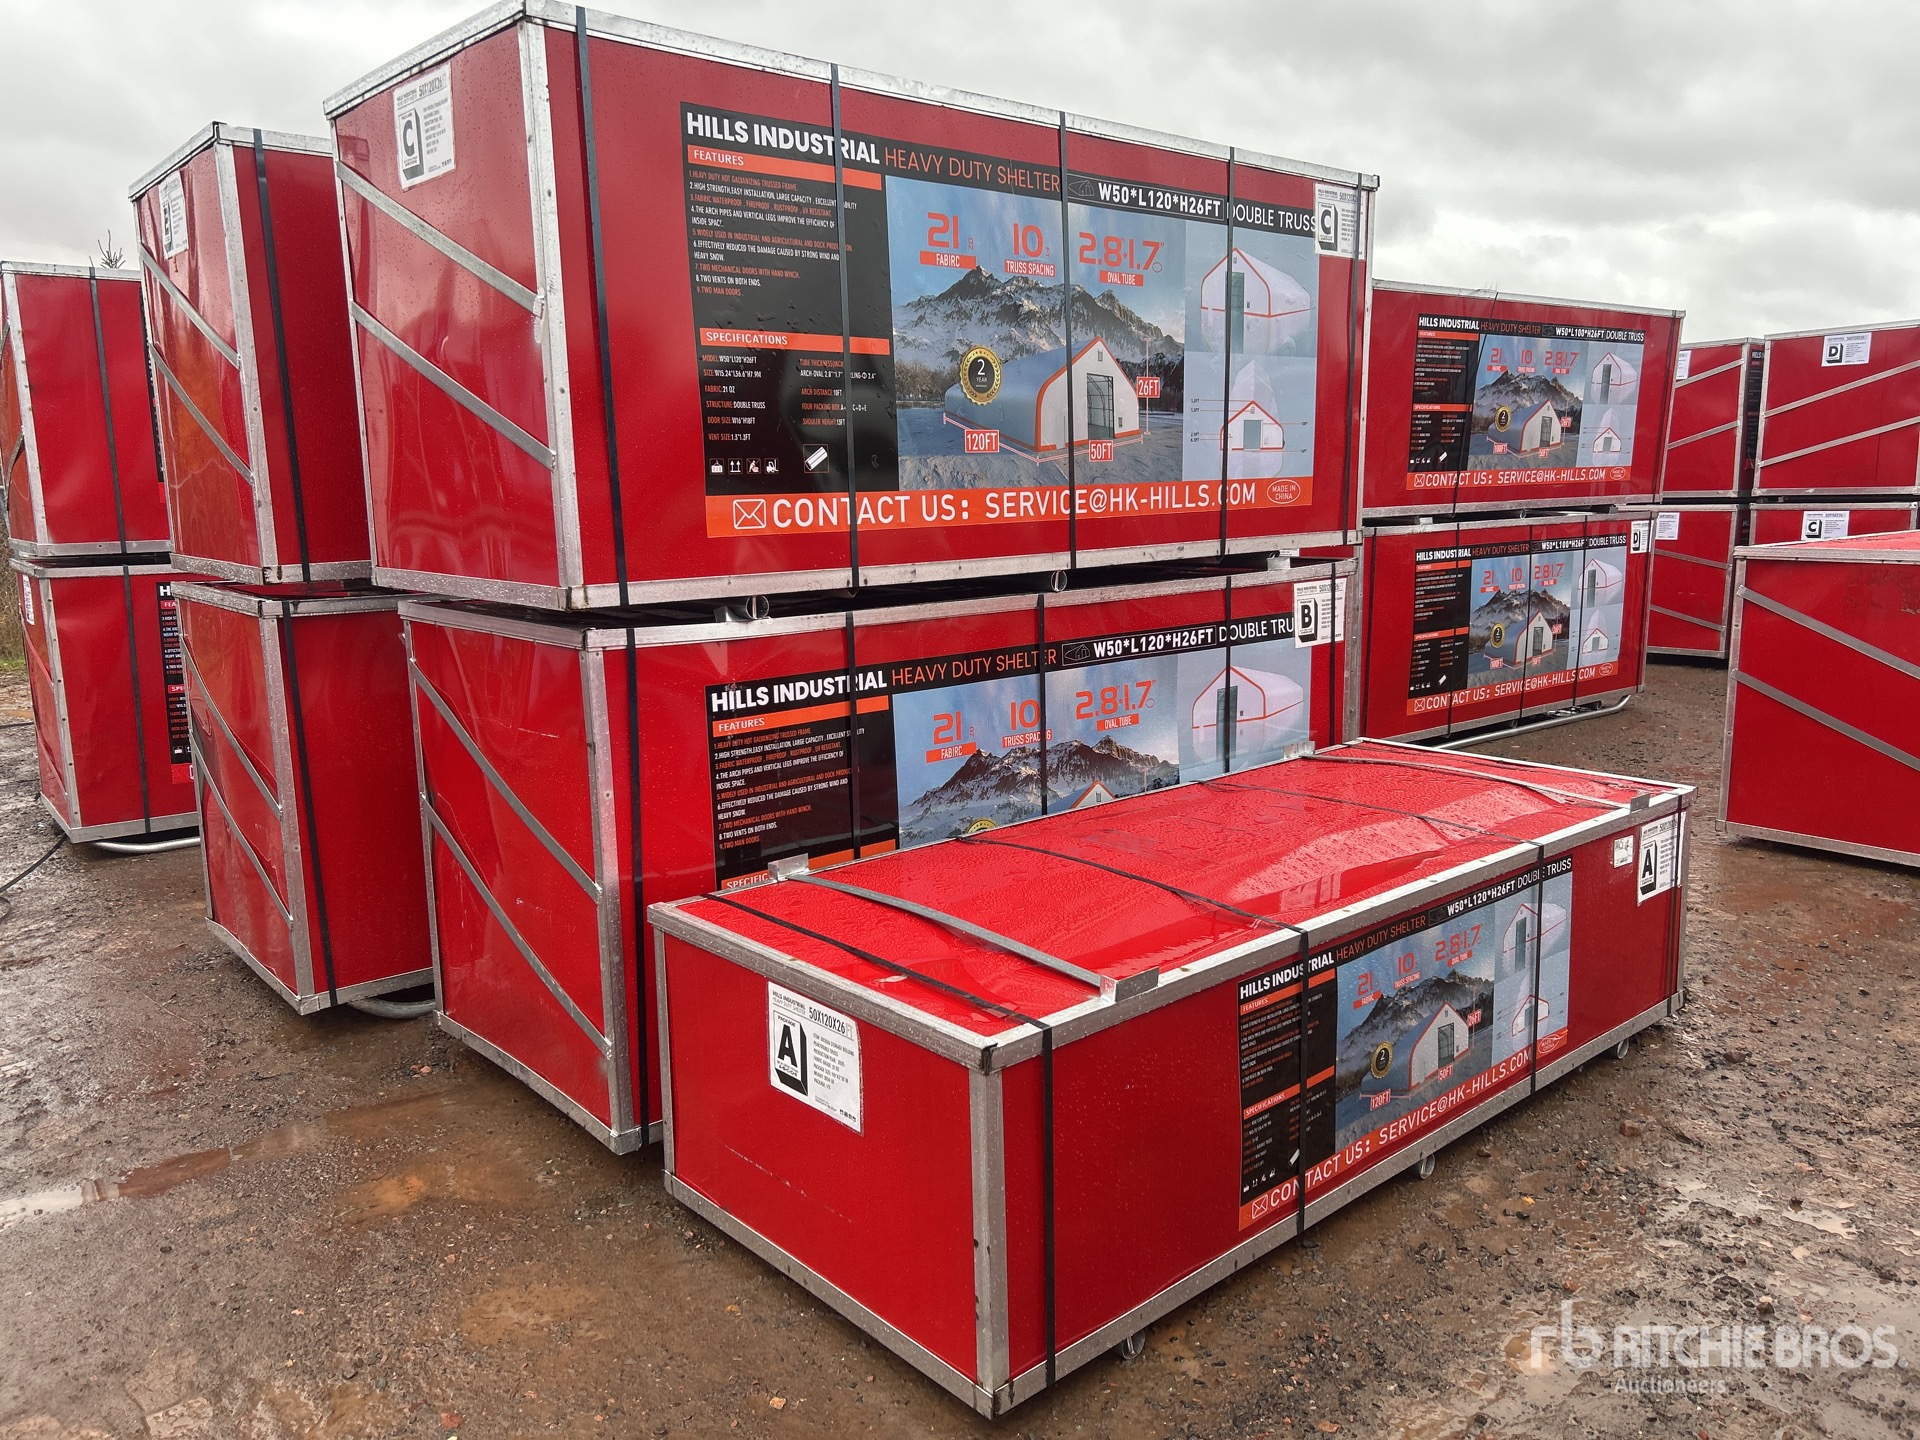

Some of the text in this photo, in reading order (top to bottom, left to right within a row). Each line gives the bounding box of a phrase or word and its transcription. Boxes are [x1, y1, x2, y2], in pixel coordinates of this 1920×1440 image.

[403, 120, 415, 157] C
[686, 112, 880, 165] HILLS INDUSTRIAL
[694, 149, 744, 166] FEATURES
[884, 147, 1060, 193] HEAVY DUTY SHELTER
[776, 192, 790, 201] LARGE
[692, 216, 707, 226] INSIDE
[705, 207, 718, 215] ARCH
[719, 208, 732, 217] PIPES
[733, 210, 742, 218] AND
[743, 211, 764, 220] VERTICAL
[766, 214, 776, 222] LEGS
[777, 215, 796, 224] IMPROVE
[797, 217, 805, 225] THE
[806, 218, 828, 227] EFFICIENCY
[1321, 209, 1331, 236] C
[928, 212, 960, 249] 21
[1012, 224, 1044, 258] 10
[694, 251, 708, 260] HEAVY
[726, 243, 746, 252] REDUCED
[757, 246, 775, 254] DAMAGE
[777, 248, 794, 256] CAUSED
[802, 251, 818, 259] STRONG
[819, 252, 830, 260] WIND
[936, 254, 960, 268] FABIRC
[1006, 260, 1054, 276] TRUSS SPACING
[712, 276, 726, 284] VENTS
[1107, 272, 1136, 286] OVAL TUBE
[1419, 316, 1541, 334] HILLS INDUSTRIAL HEAVY DUTY SHELTER
[706, 332, 788, 346] SPECIFICATIONS
[1606, 330, 1644, 342] DOUBLE TRUSS
[1491, 347, 1503, 363] 21
[1521, 349, 1532, 364] 10
[1828, 345, 1838, 358] D
[977, 358, 986, 376] 2
[1138, 380, 1160, 396] 26FT
[966, 432, 998, 450] 120FT
[1090, 442, 1112, 459] 50FT
[1425, 468, 1606, 486] CONTACT US: SERVICE@HK-HILLS.COM
[1272, 484, 1296, 492] MADE IN
[773, 482, 1256, 528] CONTACT US: SERVICE@HK-HILLS.COM
[1808, 522, 1817, 532] C
[1541, 539, 1588, 550] W50L100H26F
[1589, 536, 1626, 547] DOUBLE TRUSS
[1634, 532, 1639, 544] D
[1416, 551, 1433, 561] HILLS
[1472, 547, 1491, 556] HEAVY
[1492, 545, 1506, 554] DUTY
[1508, 544, 1529, 553] SHELTER
[1483, 570, 1494, 585] 21
[1512, 567, 1522, 582] 10
[1301, 604, 1312, 628] B
[1270, 616, 1294, 634] TRU
[892, 662, 948, 686] HEAVY
[952, 656, 992, 678] DUTY
[712, 686, 770, 712] HILLS
[1473, 688, 1490, 700] US:
[1011, 699, 1040, 730] 10
[1104, 716, 1132, 730] OVAL TUBE
[718, 718, 765, 732] FEATURES
[933, 711, 962, 745] 21
[1004, 734, 1024, 746] TRUSS
[941, 745, 963, 759] FABIRC
[1547, 858, 1572, 876] TRUSS
[1642, 848, 1653, 878] A
[1336, 915, 1426, 961] HEAVY DUTY SHELTER
[1398, 952, 1415, 976] 10
[1240, 977, 1270, 999] HILLS
[1358, 970, 1373, 996] 21
[773, 990, 805, 1009] HILLS INDUSTRIAL
[1242, 998, 1268, 1012] FEATURES
[778, 1015, 796, 1027] PACKAGE
[809, 1006, 845, 1034] 50X120X26
[778, 1024, 798, 1068] A
[1380, 1050, 1385, 1061] 2
[1246, 1093, 1285, 1116] SPECIFICATIONS
[1346, 1140, 1370, 1165] US:
[1378, 1047, 1532, 1144] SERVICE@HK-HILLS.COM
[1371, 1090, 1390, 1109] 120FT
